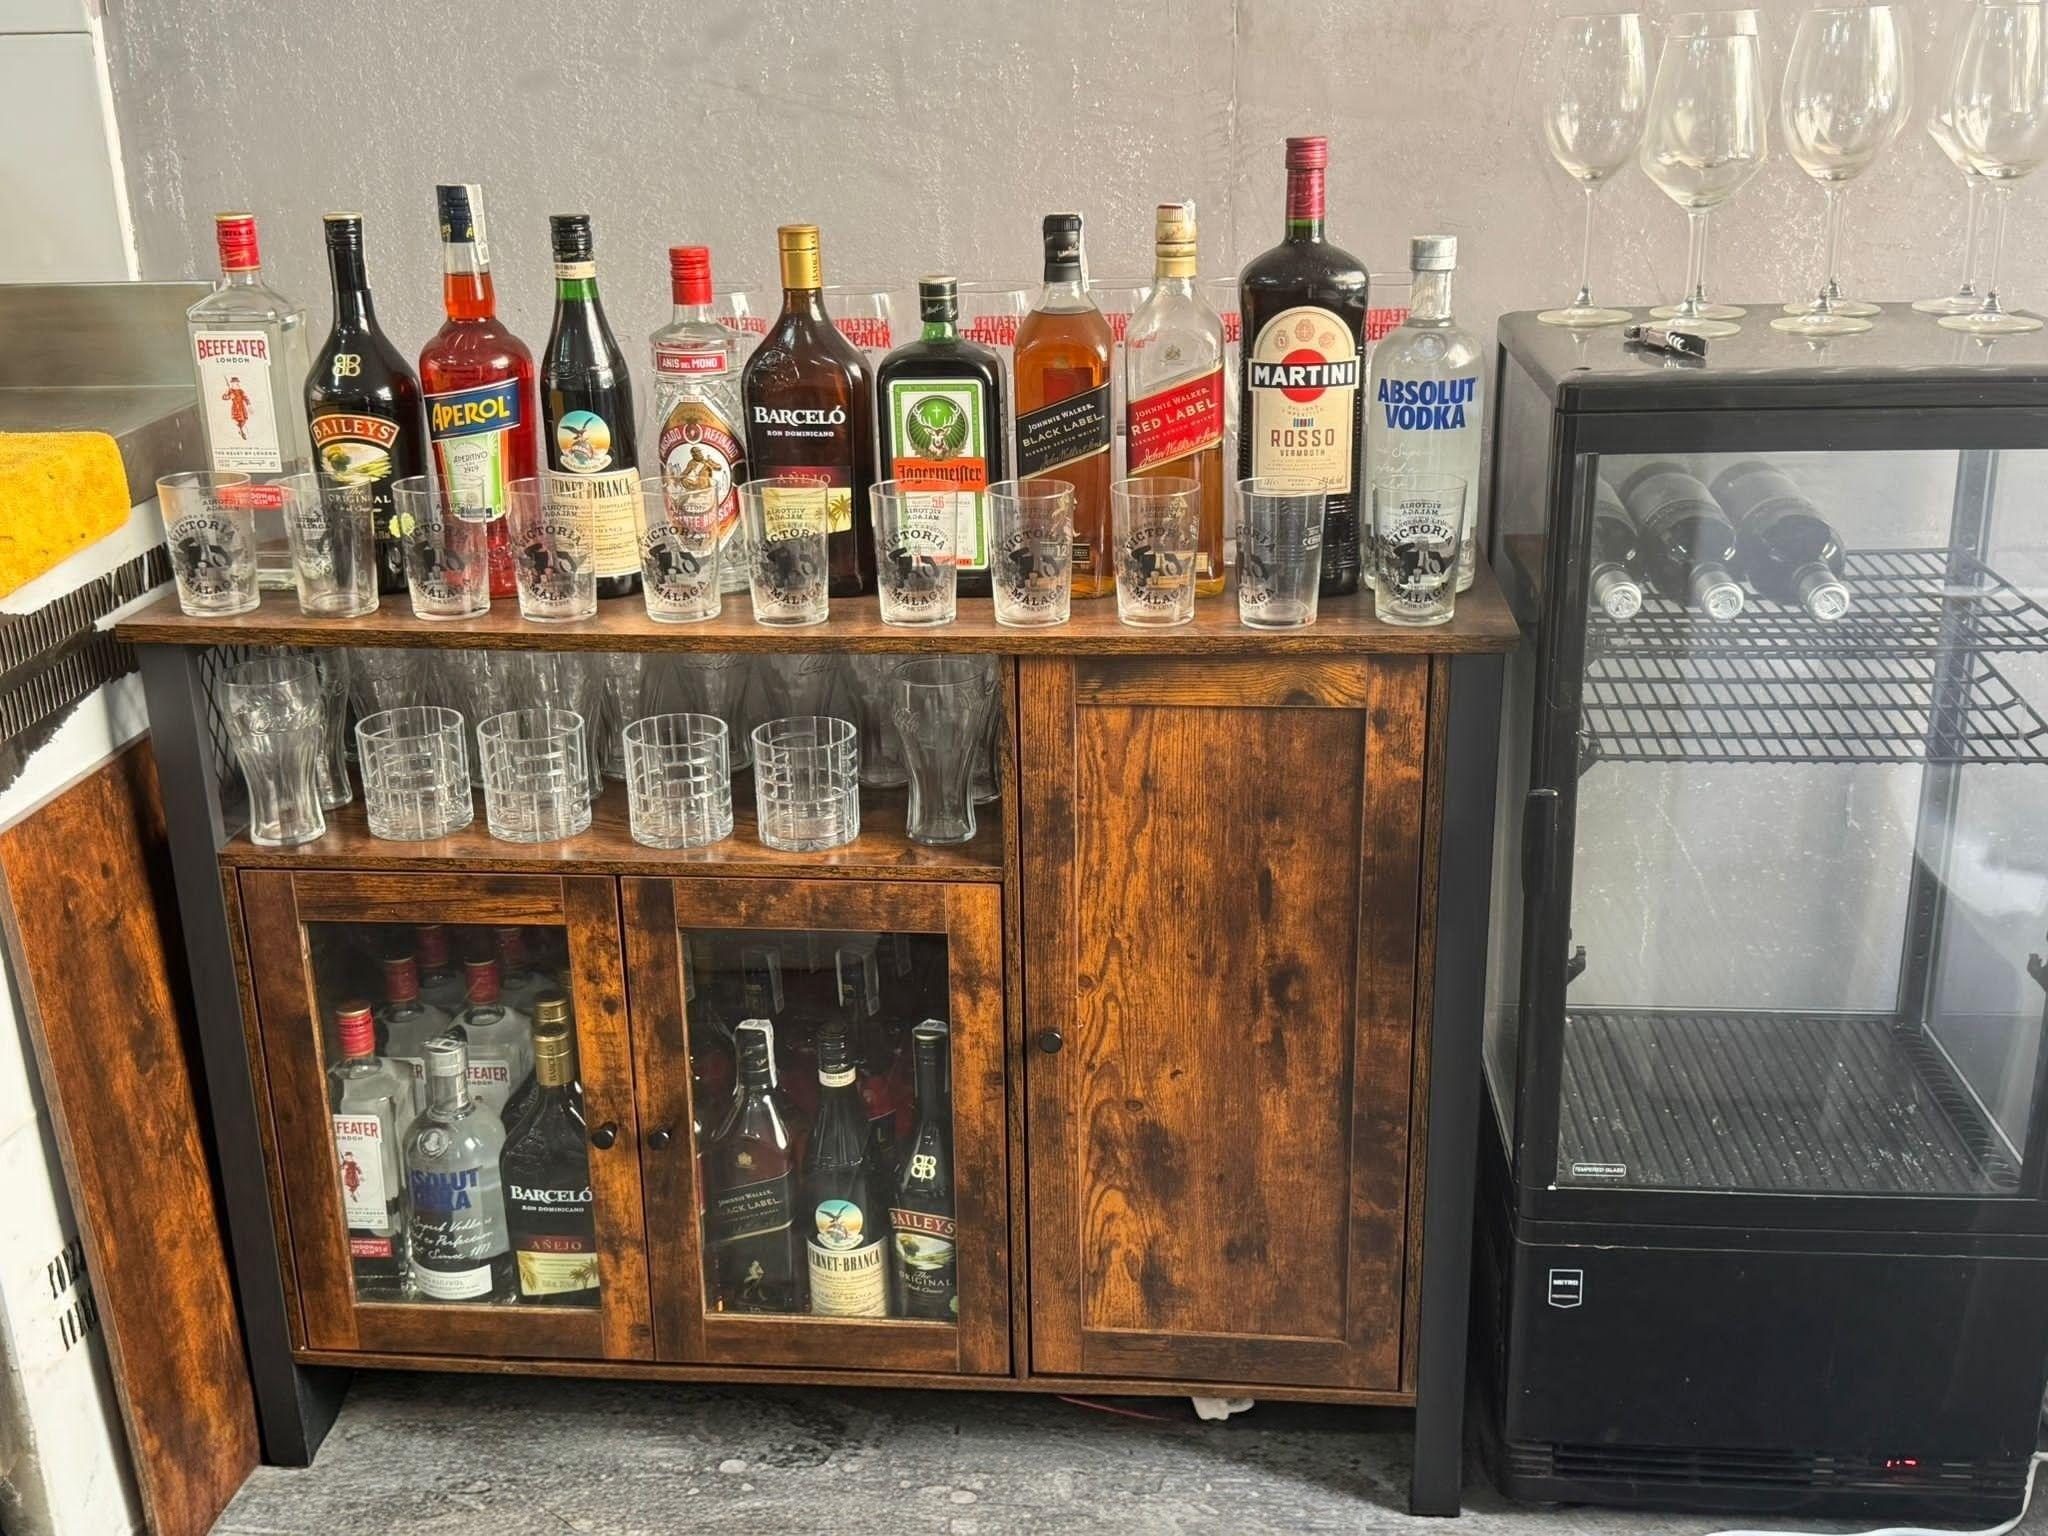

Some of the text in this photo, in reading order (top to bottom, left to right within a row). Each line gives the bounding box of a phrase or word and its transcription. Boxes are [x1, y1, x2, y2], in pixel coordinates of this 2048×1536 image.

[197, 340, 267, 360] BEEFEATER
[691, 358, 718, 368] MONO
[1254, 363, 1353, 386] MARTINI
[1377, 377, 1476, 405] ABSOLUT
[433, 396, 510, 432] APEROL
[753, 405, 846, 426] BARCELÓ
[1136, 401, 1172, 421] JOHNNIE
[1385, 404, 1466, 430] VODKA
[313, 419, 391, 440] BAILEYS
[1028, 415, 1060, 433] JOHNNIE
[1131, 418, 1161, 436] RED
[1022, 427, 1061, 447] BLACK
[1271, 429, 1334, 447] ROSSO
[453, 451, 488, 464] APERITIVO
[882, 529, 945, 551] VICTORIA
[1389, 524, 1453, 547] VICTORIA
[464, 1067, 508, 1081] FEATER
[336, 1121, 379, 1138] FEATER
[510, 1185, 592, 1204] BARCELÓ
[532, 1240, 582, 1250] AÑEJO
